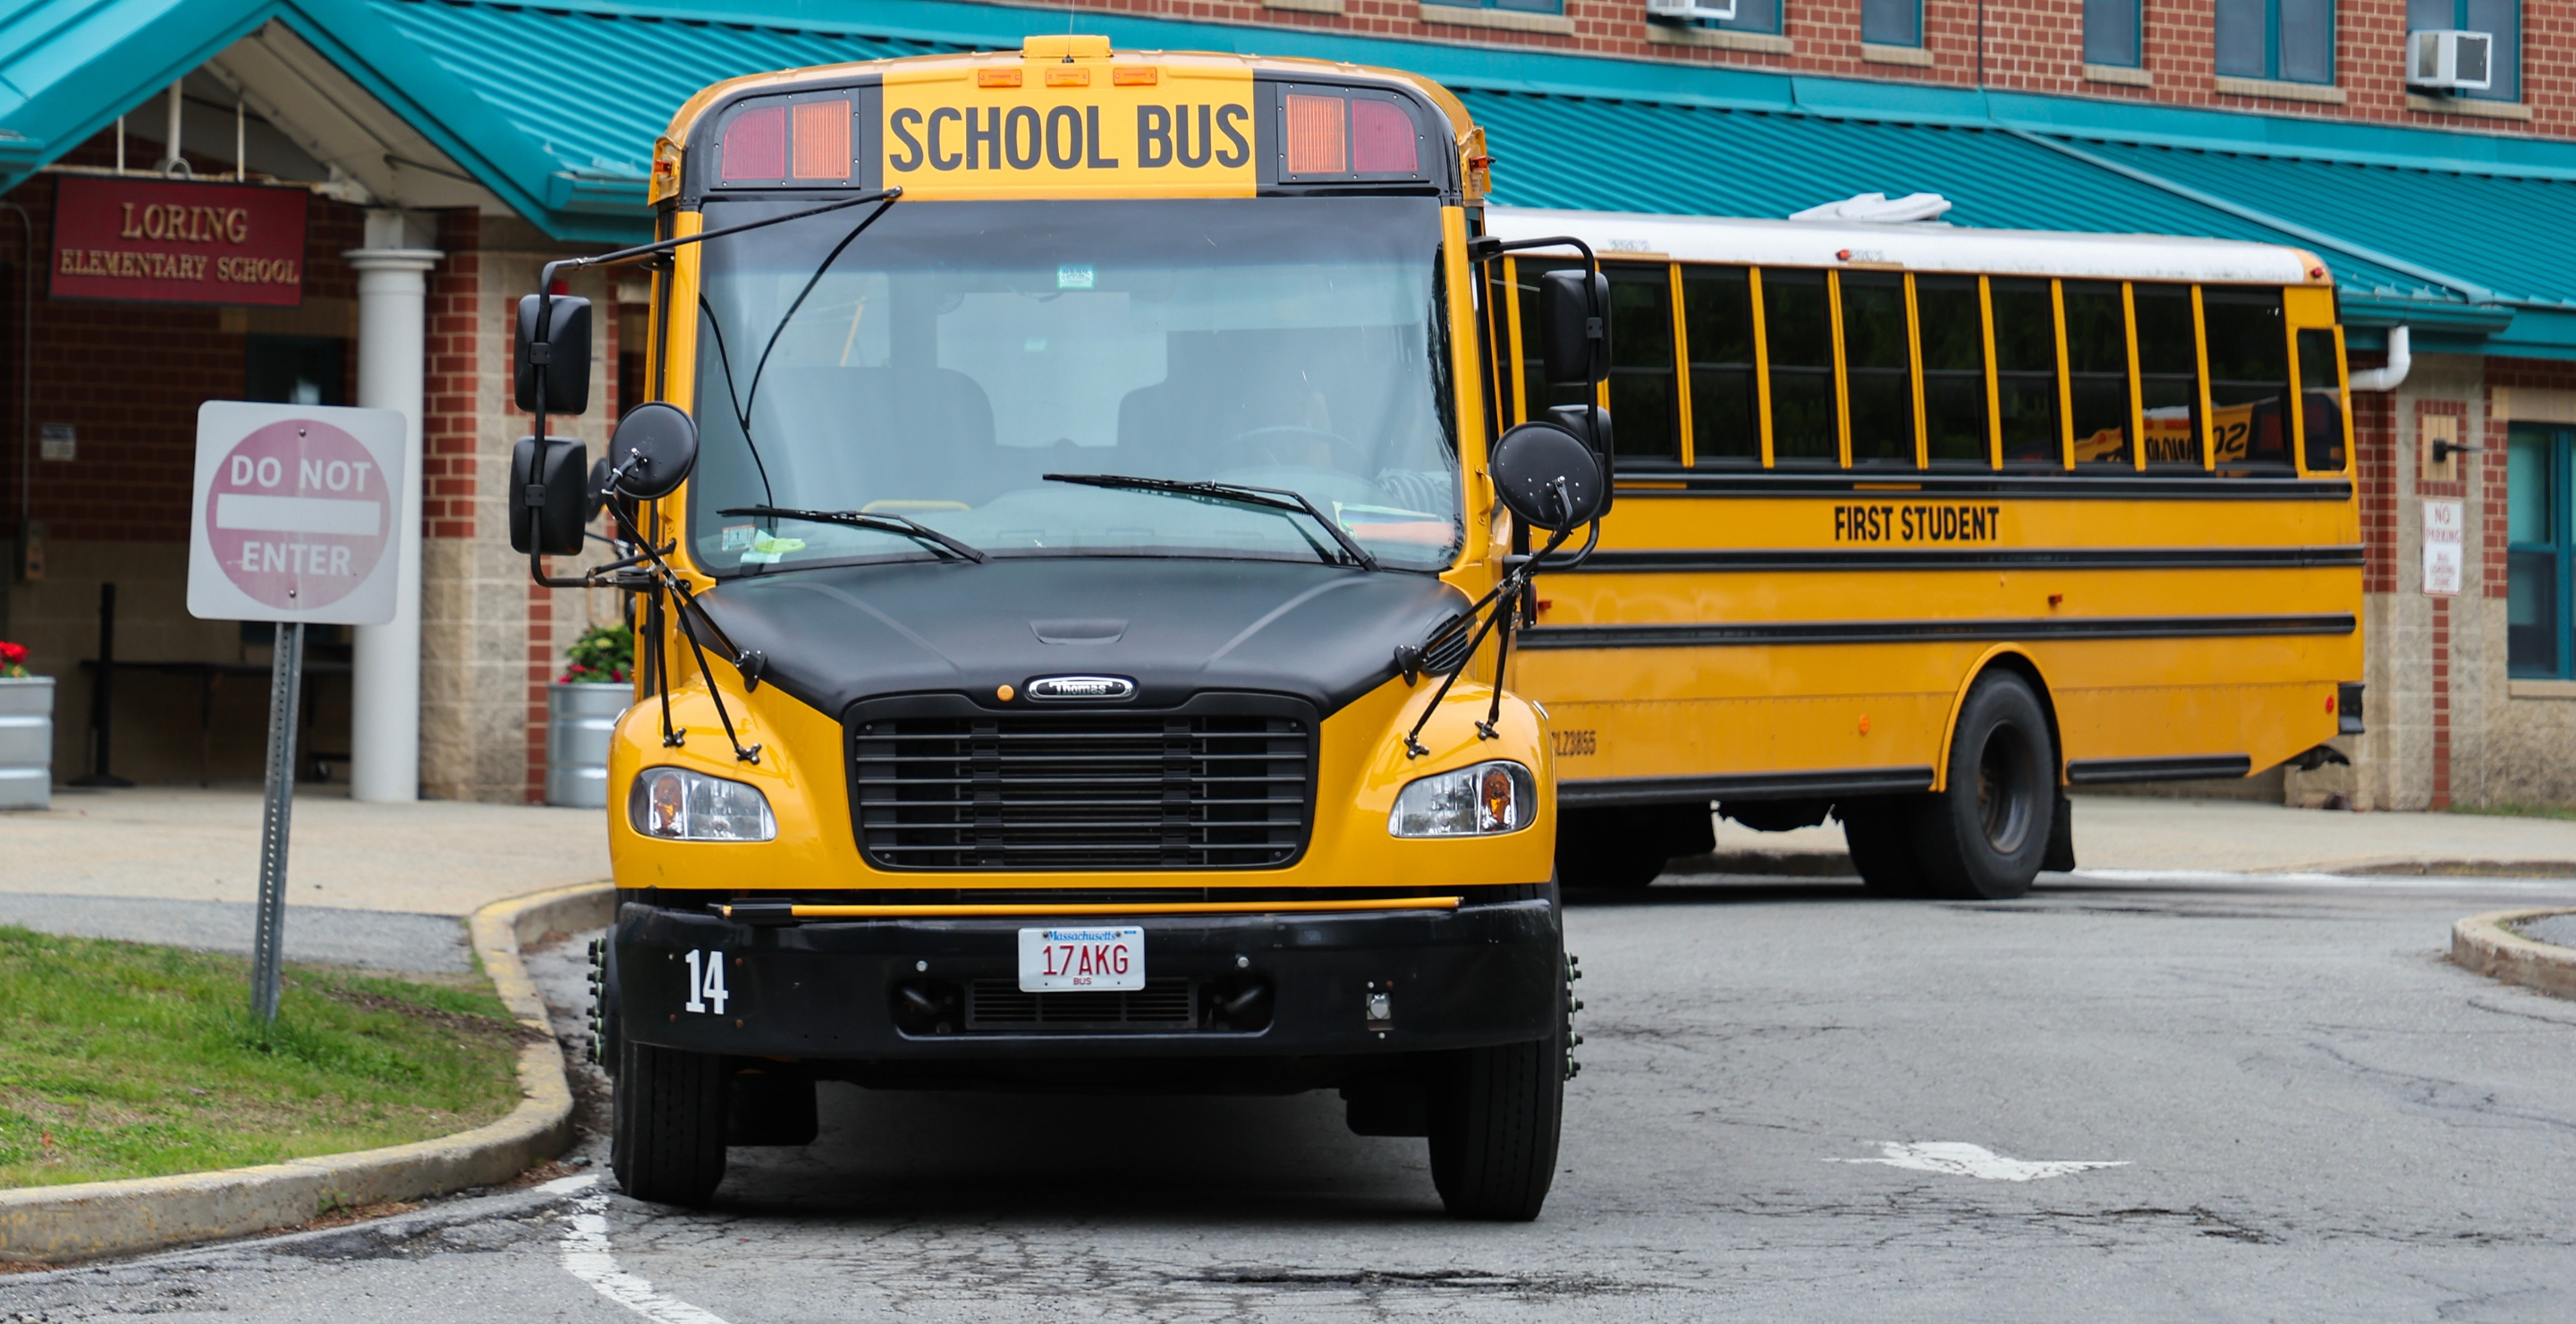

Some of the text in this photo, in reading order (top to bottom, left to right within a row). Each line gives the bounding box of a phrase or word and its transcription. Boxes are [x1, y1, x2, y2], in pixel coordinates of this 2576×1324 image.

[888, 103, 1250, 173] SCHOOL BUS
[121, 202, 249, 243] LORING
[60, 249, 301, 285] ELEMENTARY SCHOOL
[230, 454, 372, 493] DO NOT
[1835, 505, 2000, 541] FIRST STUDENT
[2434, 505, 2450, 525] NO
[2426, 528, 2460, 544] PARKING
[241, 540, 352, 576] ENTER
[1049, 681, 1113, 696] Thomas
[1047, 930, 1116, 941] Massachusetts
[1042, 944, 1129, 975] 17AKG
[685, 948, 729, 1015] 14
[1072, 977, 1092, 986] BUS
